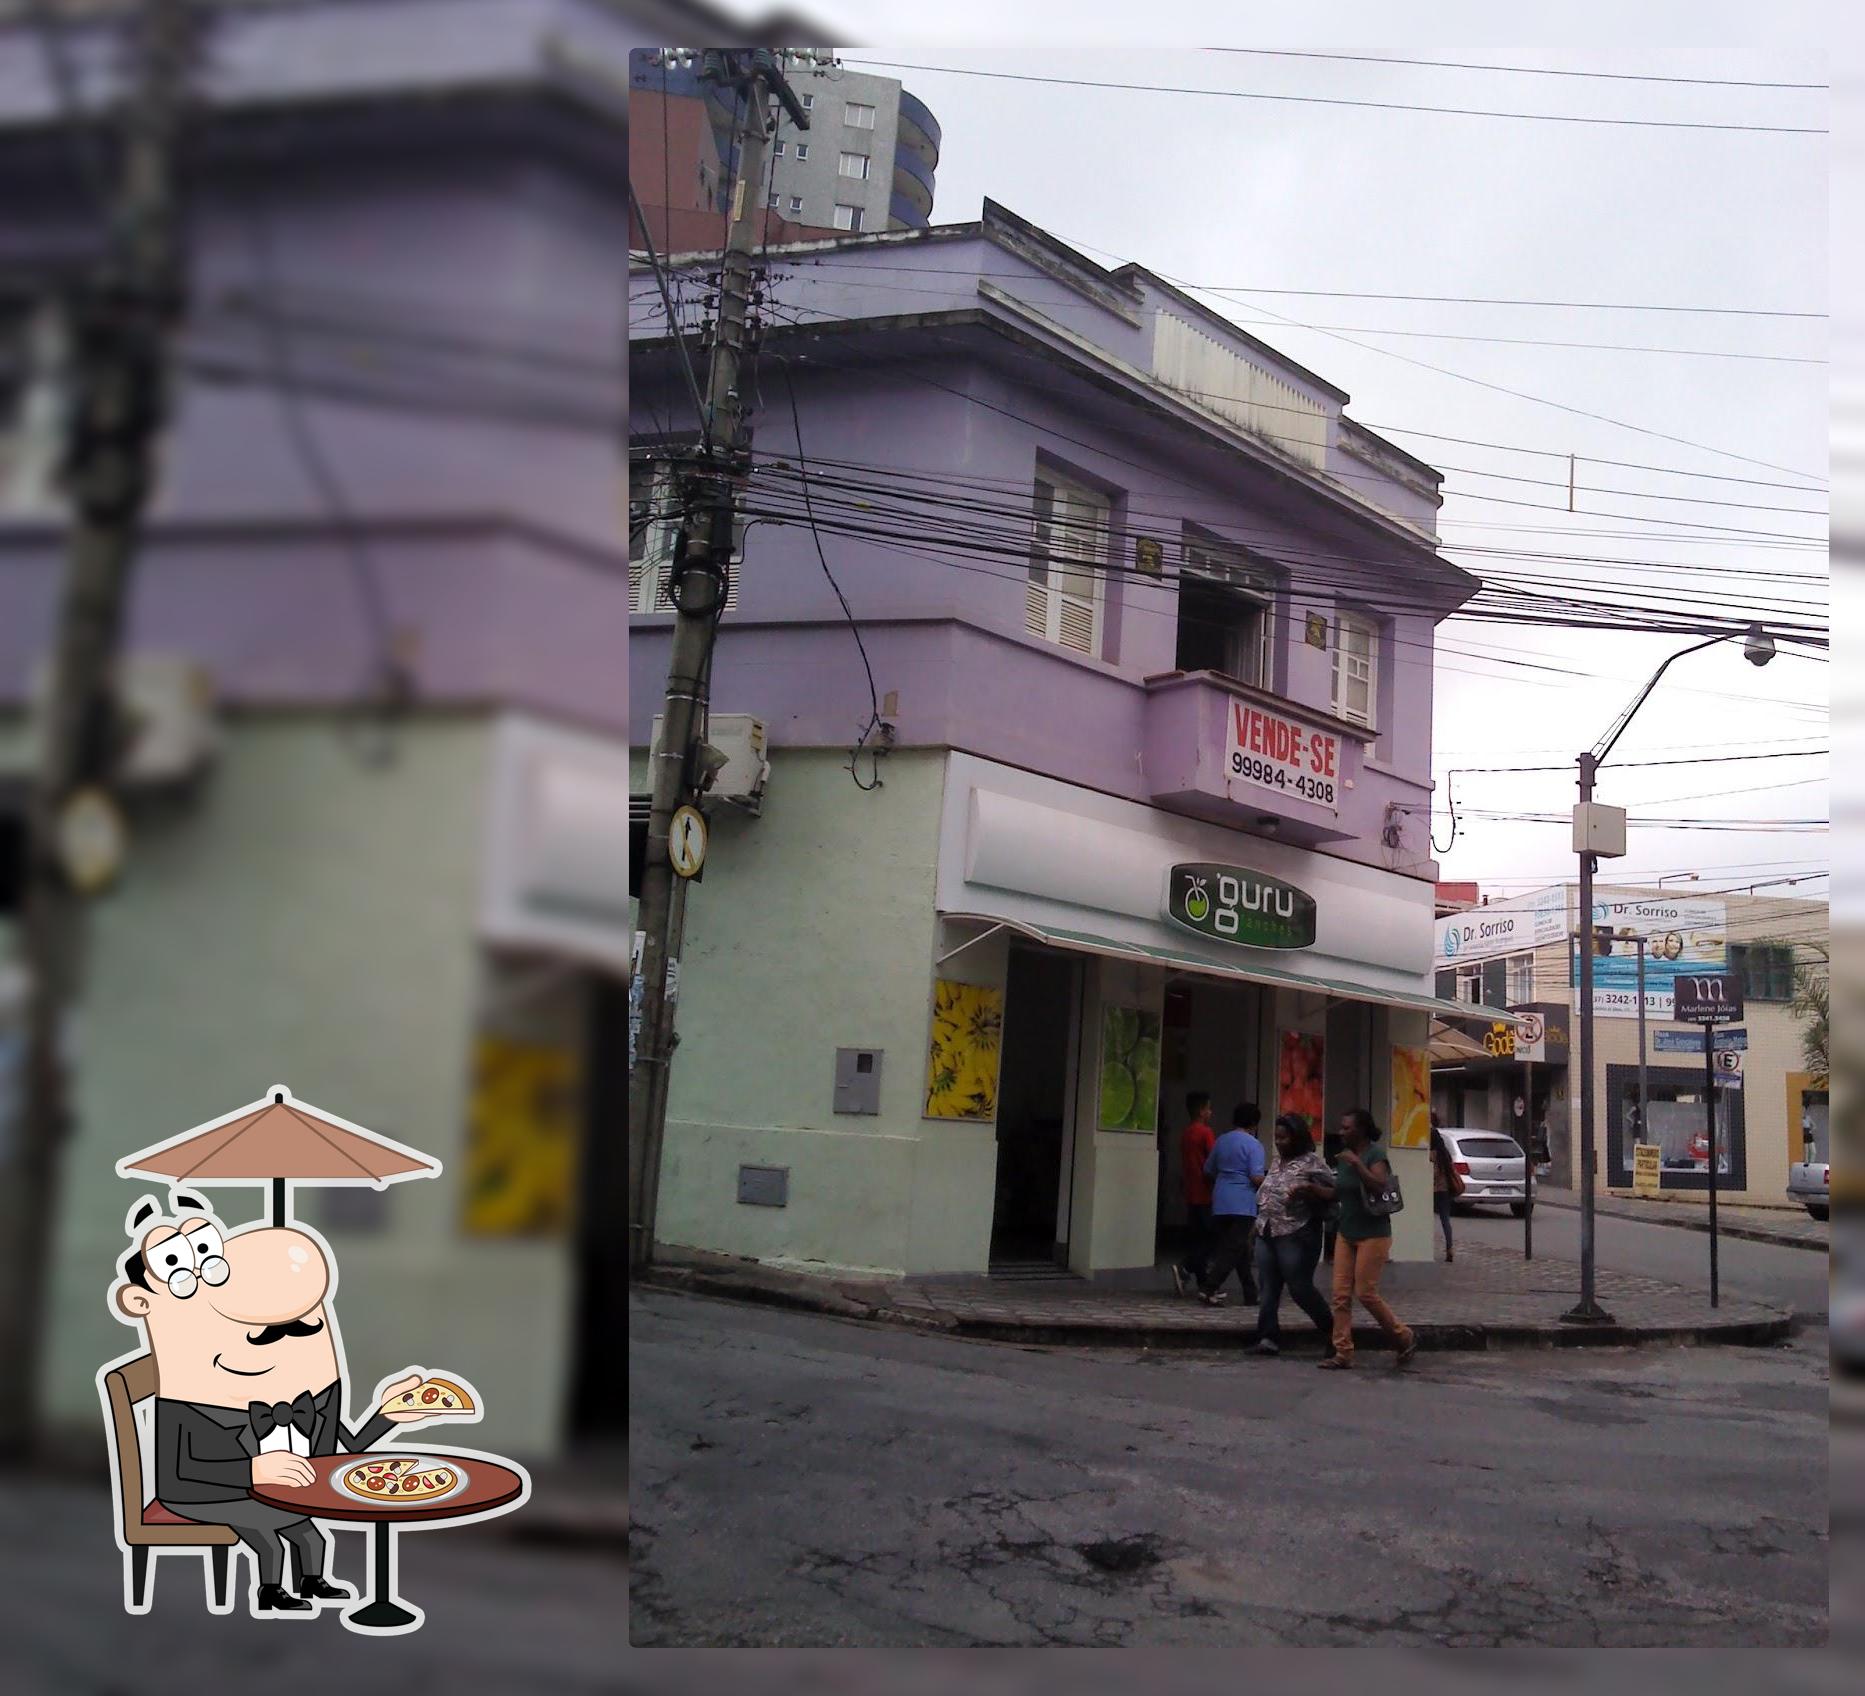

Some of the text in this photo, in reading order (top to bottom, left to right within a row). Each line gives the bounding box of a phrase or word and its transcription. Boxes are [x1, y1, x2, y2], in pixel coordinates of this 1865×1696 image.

[1234, 703, 1335, 778] VENDE-SE
[1232, 752, 1334, 803] 99984-4308
[1214, 872, 1294, 934] guru
[1613, 904, 1633, 915] Dr.
[1635, 905, 1678, 919] Sorriso
[1463, 919, 1514, 942] Dr. Sorriso
[1606, 994, 1656, 1006] 3242-113
[1723, 1053, 1733, 1068] E
